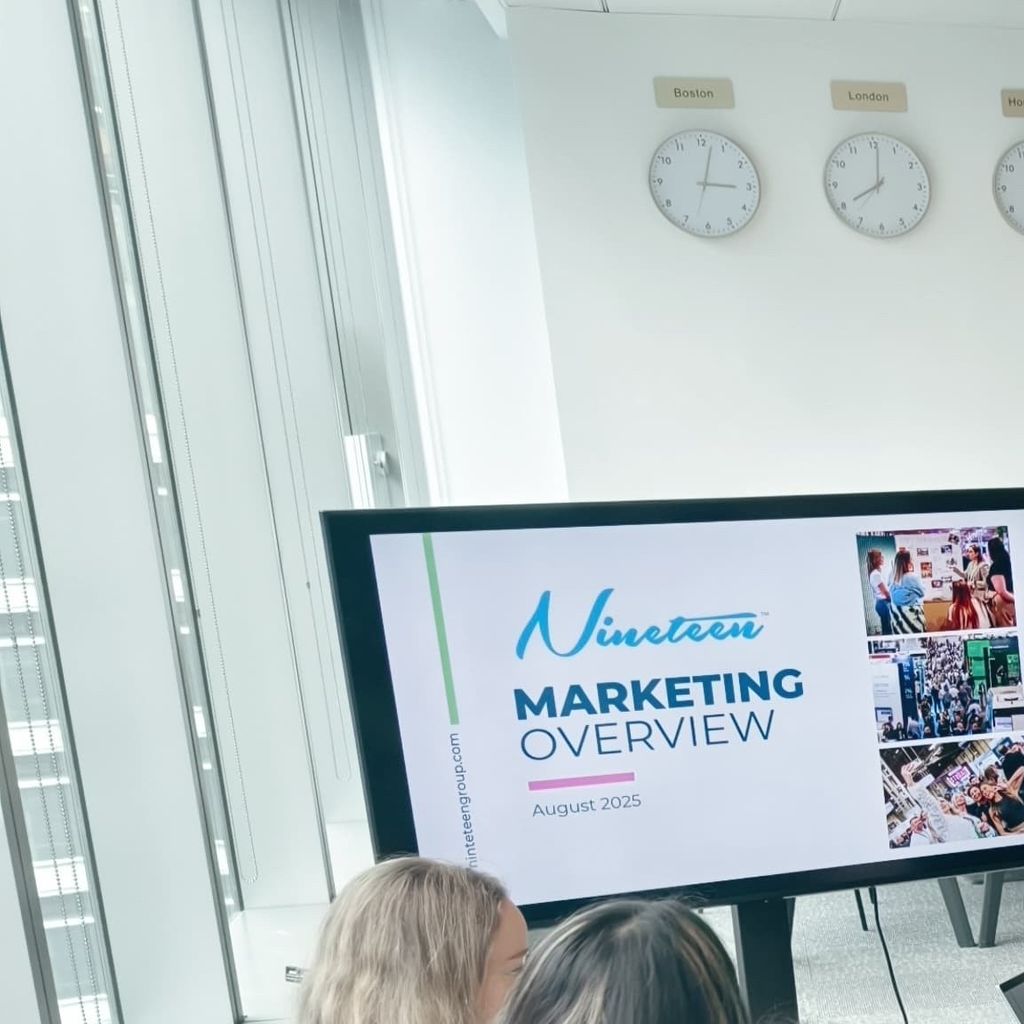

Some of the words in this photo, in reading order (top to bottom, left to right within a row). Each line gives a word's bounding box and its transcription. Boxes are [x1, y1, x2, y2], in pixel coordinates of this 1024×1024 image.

[673, 87, 714, 100] Boston
[847, 90, 890, 103] London
[697, 138, 706, 147] 12
[869, 141, 878, 150] 12
[661, 156, 672, 165] 10
[835, 160, 846, 168] 10
[1005, 164, 1015, 172] 10
[515, 588, 764, 660] Nineteen
[514, 668, 804, 721] MARKETING
[520, 709, 775, 761] OVERVIEW
[532, 799, 597, 818] August
[600, 794, 642, 811] 2025
